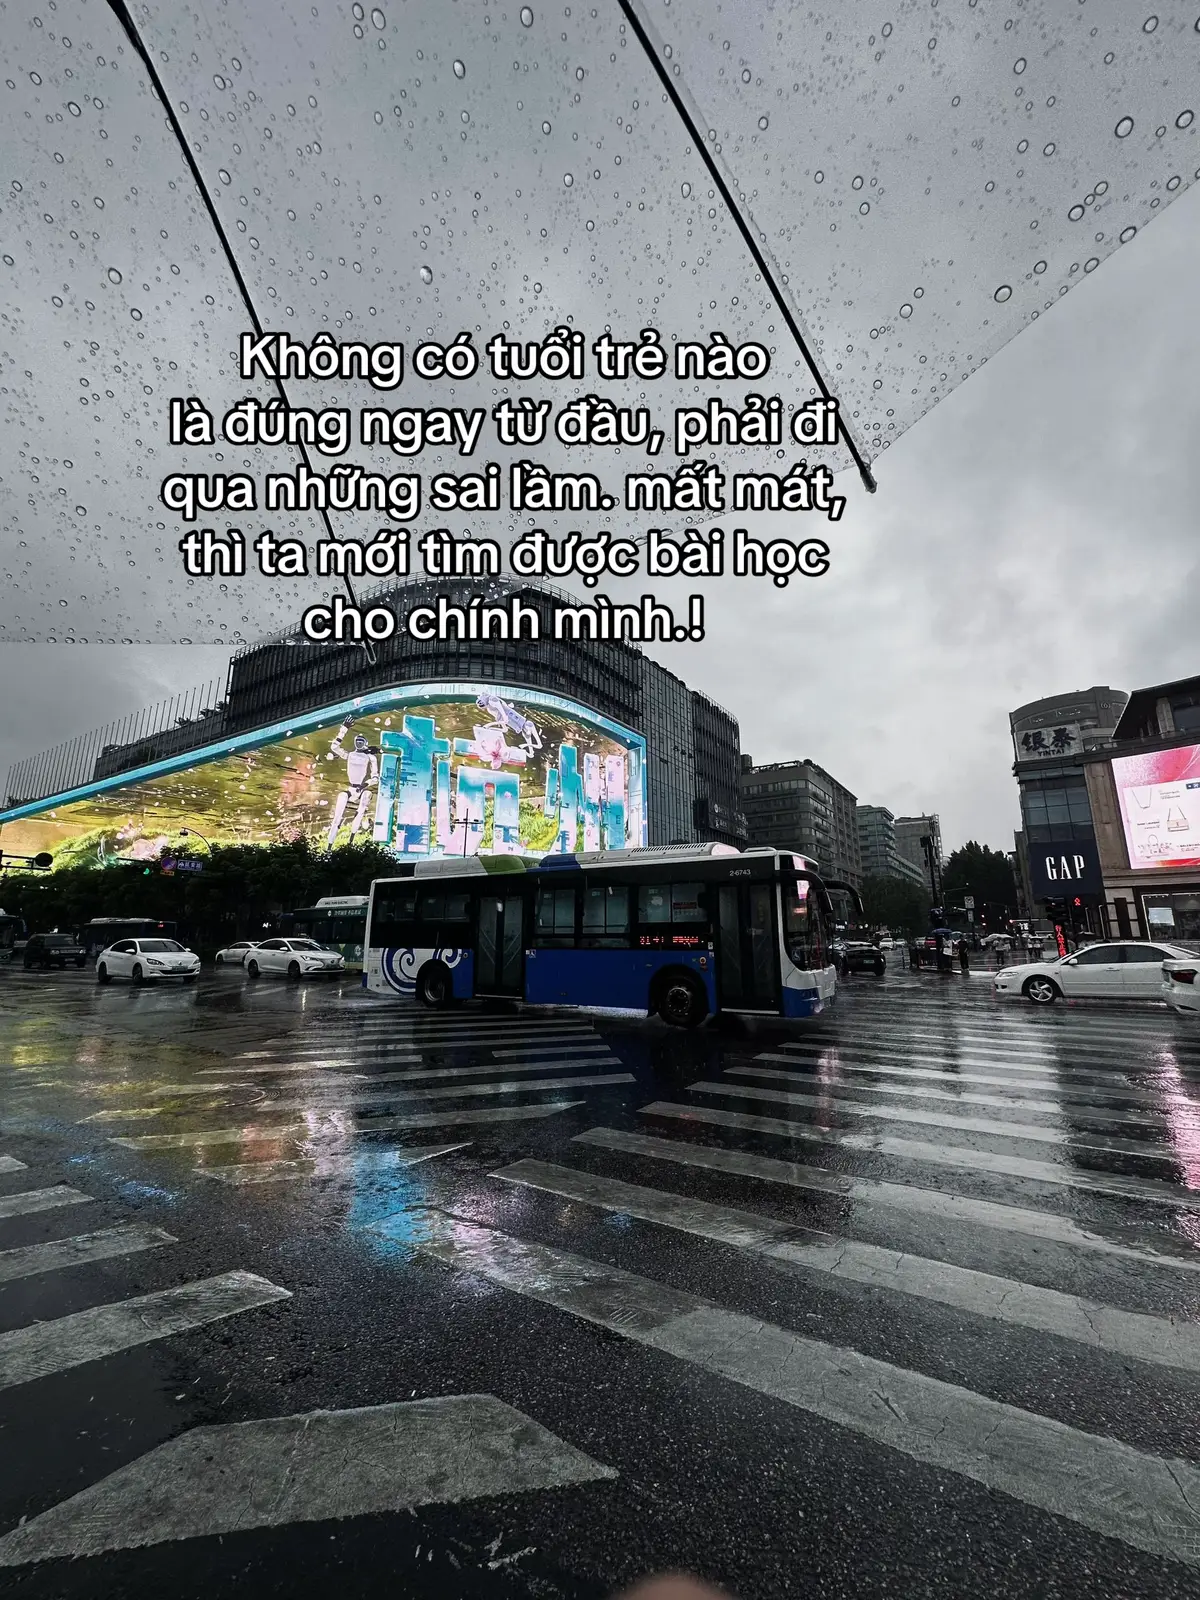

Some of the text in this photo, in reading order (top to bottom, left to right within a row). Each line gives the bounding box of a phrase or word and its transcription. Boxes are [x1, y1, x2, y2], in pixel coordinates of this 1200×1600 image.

[1021, 727, 1077, 752] 银泰
[1037, 748, 1065, 757] YINTAI
[729, 868, 752, 877] 2-6743
[1045, 854, 1086, 881] GAP
